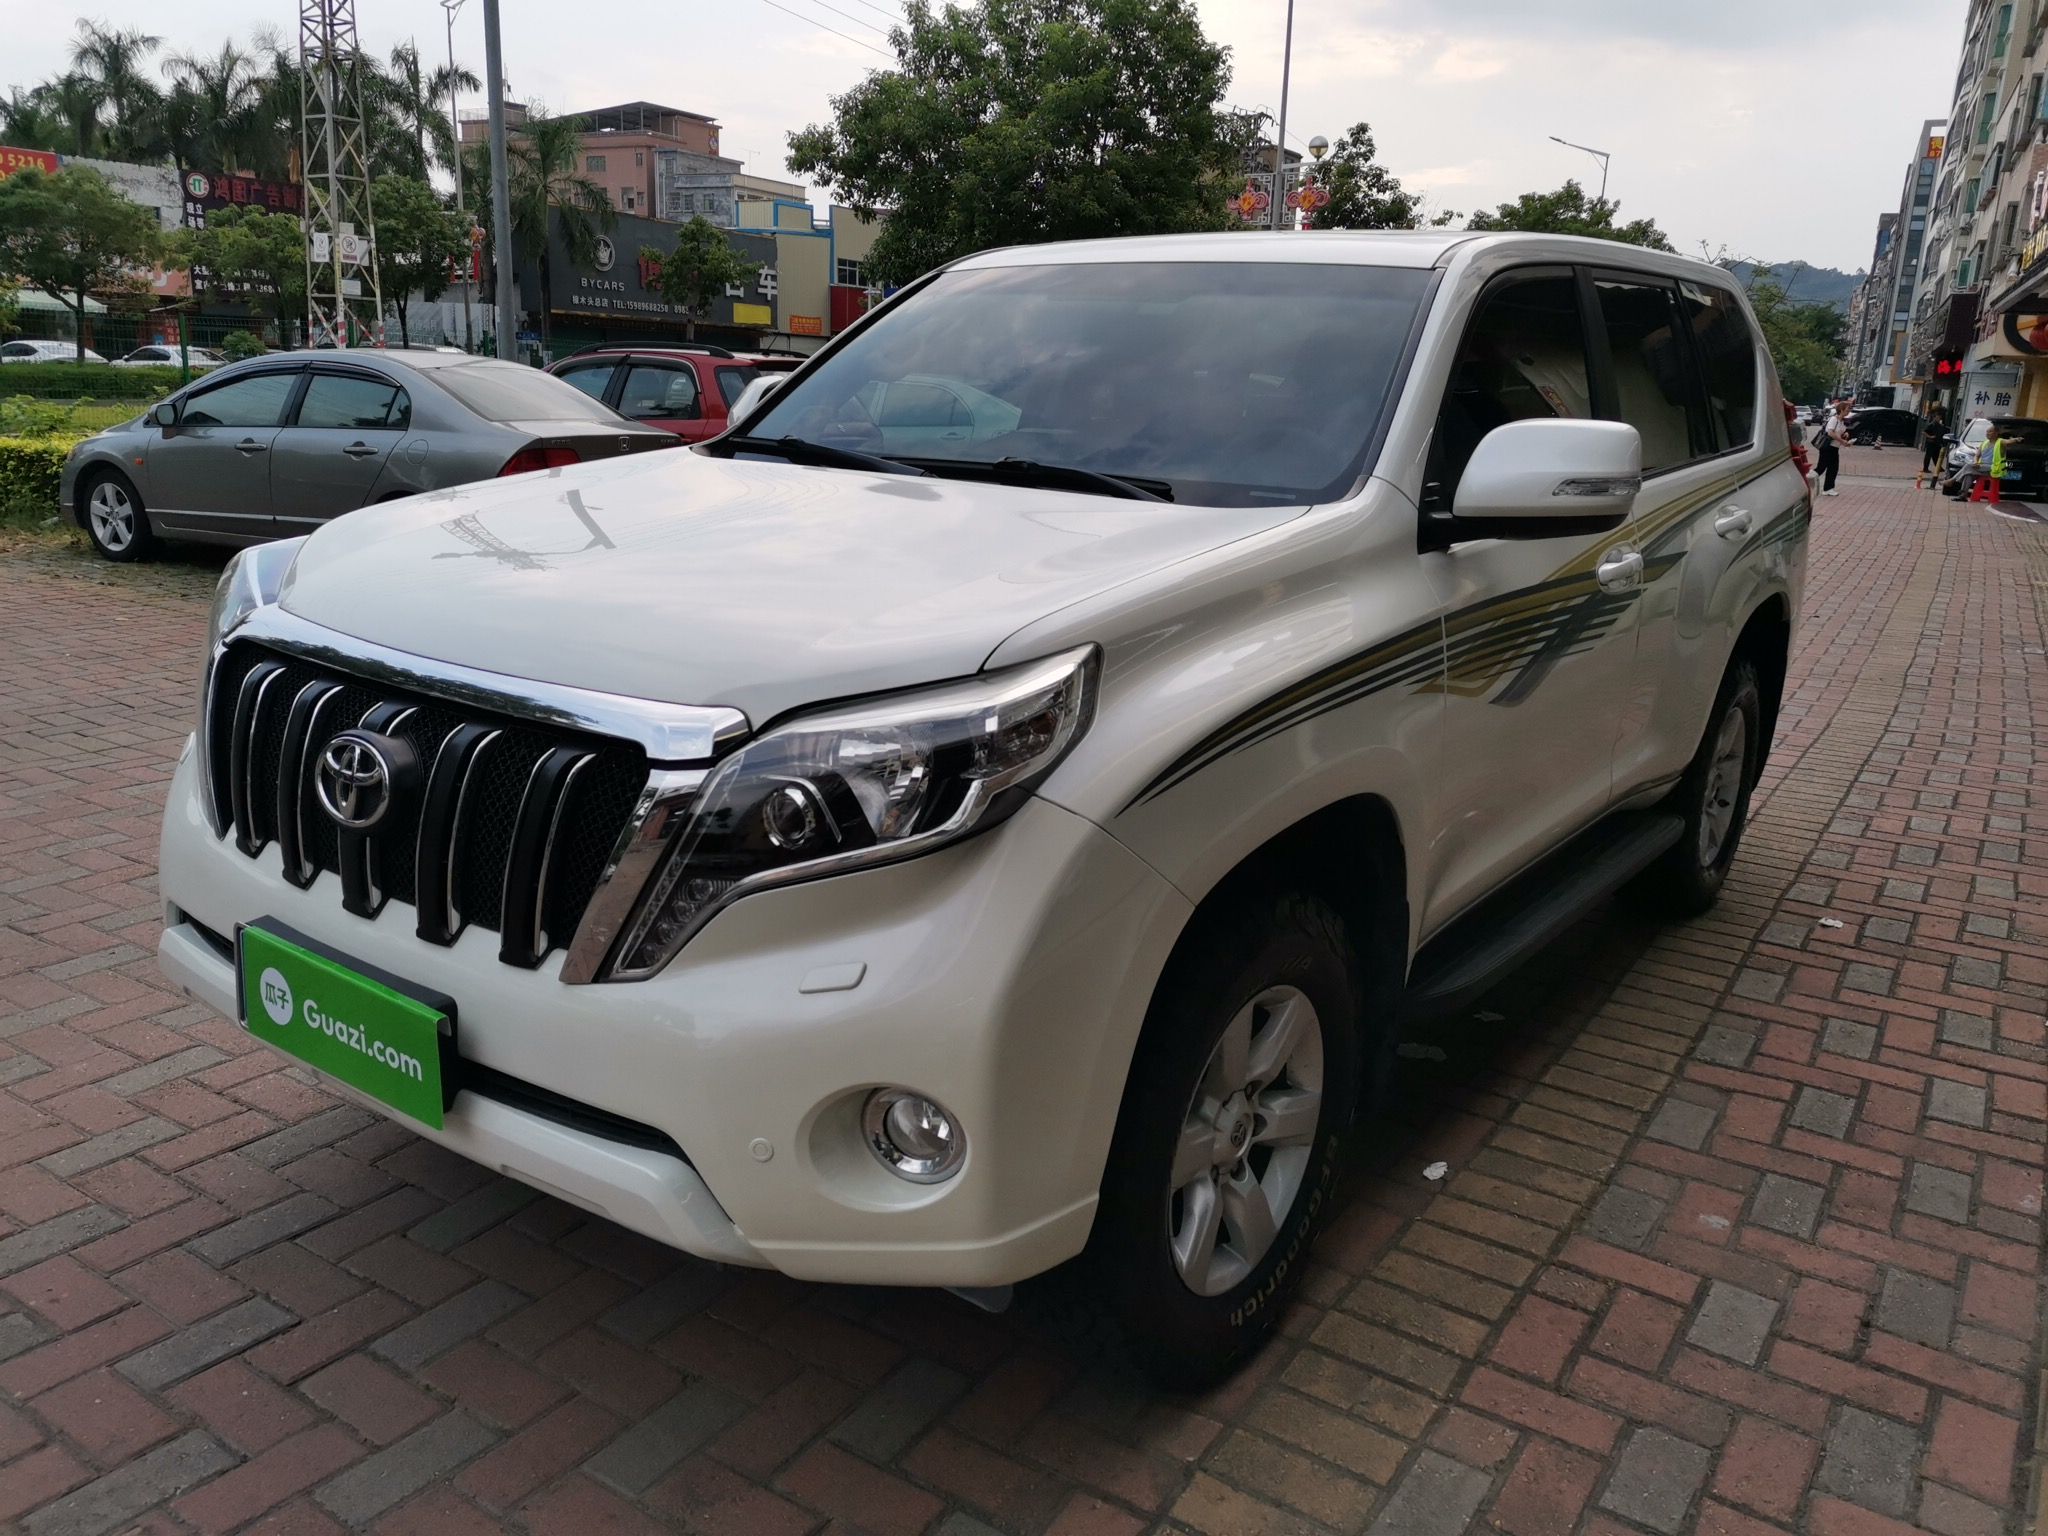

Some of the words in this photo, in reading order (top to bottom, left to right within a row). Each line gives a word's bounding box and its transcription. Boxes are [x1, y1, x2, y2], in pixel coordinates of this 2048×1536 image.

[581, 277, 625, 292] BYCARS
[1975, 391, 2012, 407] 补胎
[264, 981, 290, 1011] 瓜子
[303, 998, 424, 1082] Guazi.com
